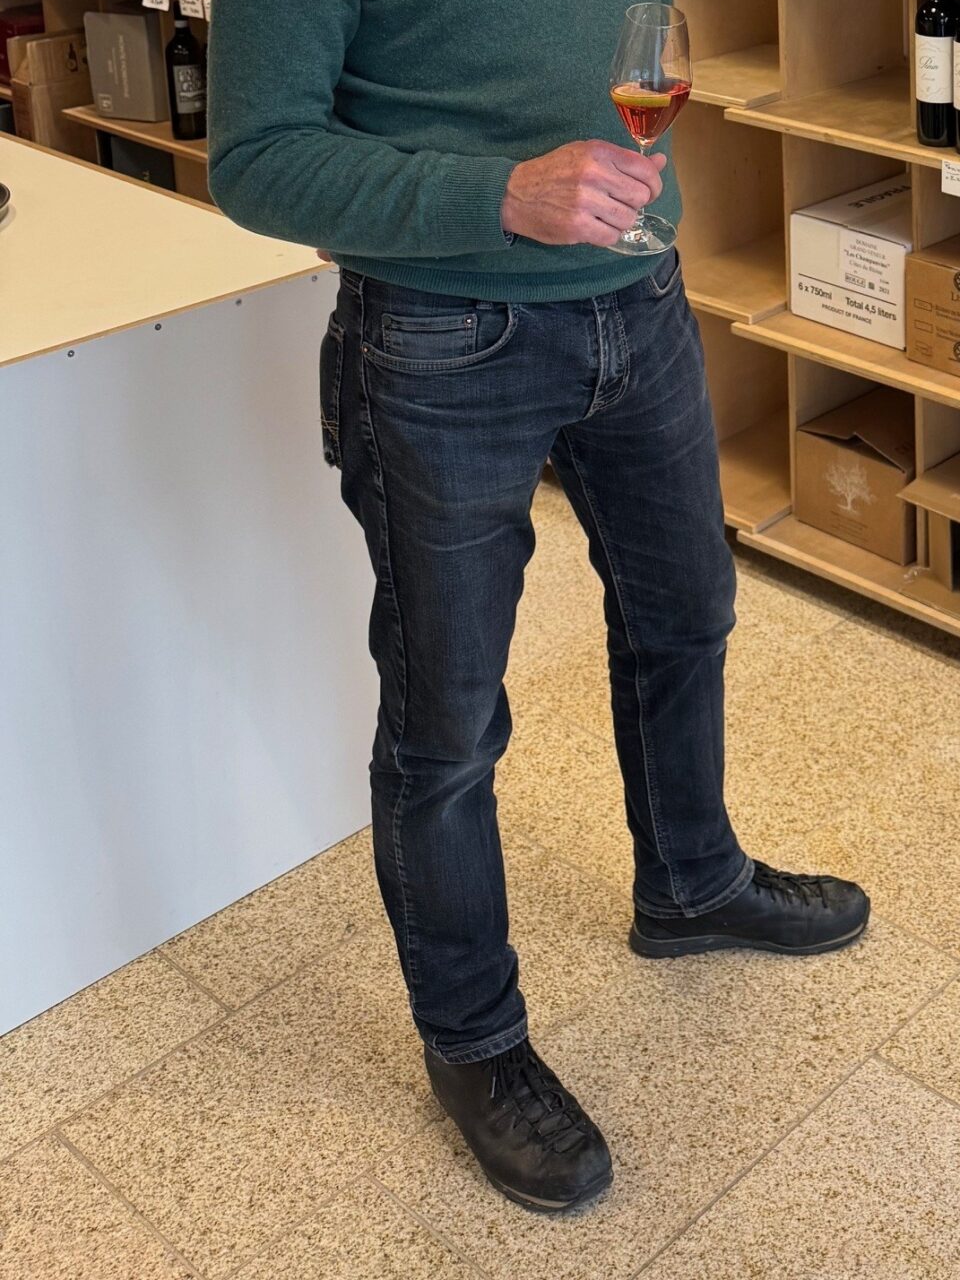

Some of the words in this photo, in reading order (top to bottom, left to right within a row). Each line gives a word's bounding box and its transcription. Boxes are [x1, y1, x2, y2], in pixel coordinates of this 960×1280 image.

[798, 282, 803, 291] 6
[811, 285, 832, 301] 750ml
[845, 296, 864, 311] Total
[878, 307, 897, 321] liters
[852, 313, 872, 325] FRANCE
